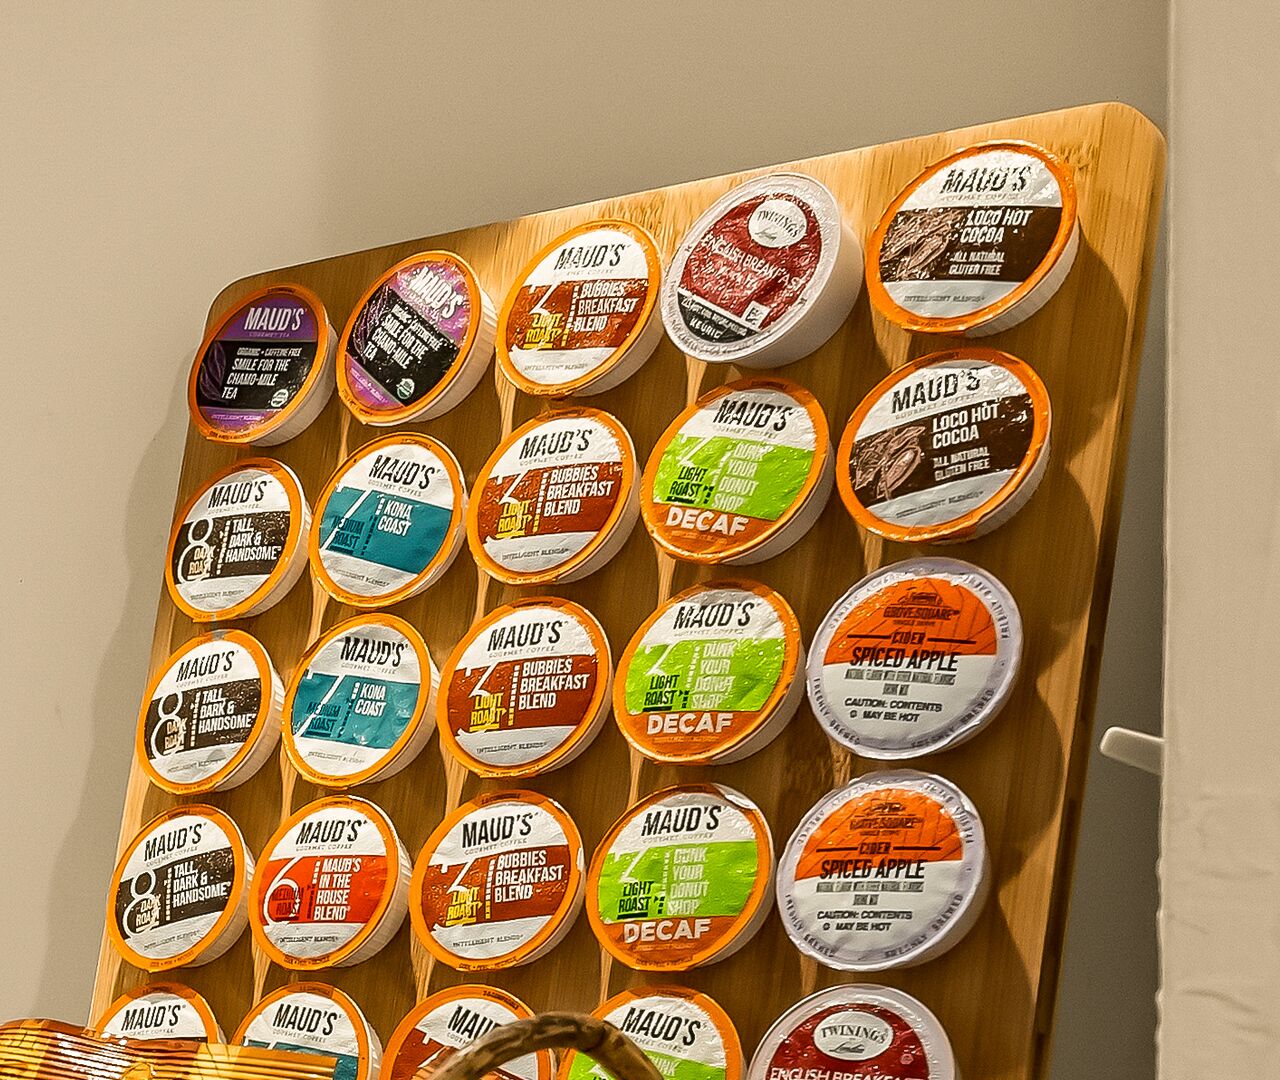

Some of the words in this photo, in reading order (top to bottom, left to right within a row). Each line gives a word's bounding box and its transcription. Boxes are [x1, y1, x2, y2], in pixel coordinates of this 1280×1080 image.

[940, 166, 1032, 194] MAUD'S
[757, 210, 799, 239] TWININGS
[966, 209, 1002, 226] LOCO
[1002, 210, 1033, 226] HOT
[960, 227, 1005, 244] COCOA
[554, 244, 625, 270] MAUD'S
[968, 251, 1005, 262] NATURAL
[948, 265, 980, 276] GLUTEN
[981, 265, 1002, 276] FREE
[409, 266, 463, 319] MAUD'S
[581, 282, 627, 298] BUBBIES
[578, 298, 640, 314] BREAKFAST
[244, 307, 304, 331] MAUD'S
[574, 315, 608, 331] BLEND
[689, 318, 722, 339] KEURIG
[382, 314, 403, 337] SMILE
[399, 327, 415, 350] FOR
[411, 339, 429, 360] THE
[363, 341, 378, 361] TEA
[371, 327, 414, 369] CHAMO-MILE
[232, 358, 258, 371] SMILE
[259, 359, 274, 371] FOR
[274, 359, 291, 371] THE
[226, 373, 279, 386] CHAMO-MILE
[221, 387, 238, 399] TEA
[891, 367, 981, 414] MAUD'S
[713, 399, 793, 431] MAUD'S
[932, 411, 969, 433] LOCO
[971, 403, 1001, 424] HOT
[519, 429, 593, 460] MAUD'S
[932, 424, 980, 449] COCOA
[950, 446, 990, 465] NATURAL
[368, 454, 436, 490] MAUD'S
[550, 466, 599, 483] BUBBIES
[678, 466, 709, 483] LIGHT
[968, 457, 990, 474] FREE
[208, 480, 267, 508] MAUD'S
[546, 481, 614, 500] BREAKFAST
[669, 481, 703, 497] ROAST
[719, 477, 759, 496] DONUT
[384, 499, 414, 517] KONA
[503, 501, 531, 518] LIGHT
[543, 499, 581, 517] BLEND
[711, 494, 745, 511] SHOP
[377, 515, 412, 537] COAST
[666, 507, 749, 536] DECAF
[229, 532, 253, 549] DARK
[177, 517, 213, 584] 8
[225, 545, 278, 563] HANDSOME
[673, 602, 755, 630] MAUD'S
[487, 619, 563, 652] MAUD'S
[891, 632, 926, 646] CIDER
[340, 636, 405, 667] MAUD'S
[850, 647, 906, 669] SPICED
[906, 649, 962, 672] APPLE
[176, 650, 235, 682] MAUD'S
[522, 658, 573, 677] BUBBIES
[360, 683, 387, 700] KONA
[520, 673, 591, 693] BREAKFAST
[650, 675, 679, 690] LIGHT
[475, 692, 504, 709] LIGHT
[518, 692, 557, 711] BLEND
[644, 690, 678, 706] ROAST
[844, 698, 888, 709] CAUTION:
[200, 703, 226, 719] DARK
[355, 700, 387, 717] COAST
[898, 712, 920, 723] HOT
[151, 691, 183, 760] 8
[198, 715, 252, 734] HANDSOME
[647, 713, 734, 735] DECAF
[462, 812, 533, 848] MAUD'S
[641, 805, 722, 837] MAUD'S
[295, 819, 362, 845] MAUD'S
[144, 822, 203, 862] MAUD'S
[858, 842, 891, 855] CIDER
[322, 858, 362, 873] MAUD'S
[497, 850, 547, 870] BUBBIES
[820, 859, 874, 880] SPICED
[874, 859, 928, 879] APPLE
[172, 874, 198, 894] DARK
[200, 871, 208, 886] &
[319, 873, 331, 888] IN
[332, 873, 353, 889] THE
[495, 865, 565, 886] BREAKFAST
[172, 884, 228, 908] HANDSOME
[316, 889, 351, 905] HOUSE
[452, 886, 480, 905] LIGHT
[494, 884, 533, 903] BLEND
[623, 881, 654, 897] LIGHT
[123, 869, 156, 940] 8
[314, 905, 347, 921] BLEND
[447, 903, 478, 920] ROAST
[618, 896, 652, 914] ROAST
[817, 911, 859, 920] CAUTION:
[623, 919, 713, 944] DECAF
[871, 923, 892, 932] HOT
[121, 1004, 181, 1032] MAUD'S
[272, 1003, 338, 1036] MAUD'S
[621, 1007, 701, 1046] MAUD'S
[821, 1024, 889, 1045] TWININGS
